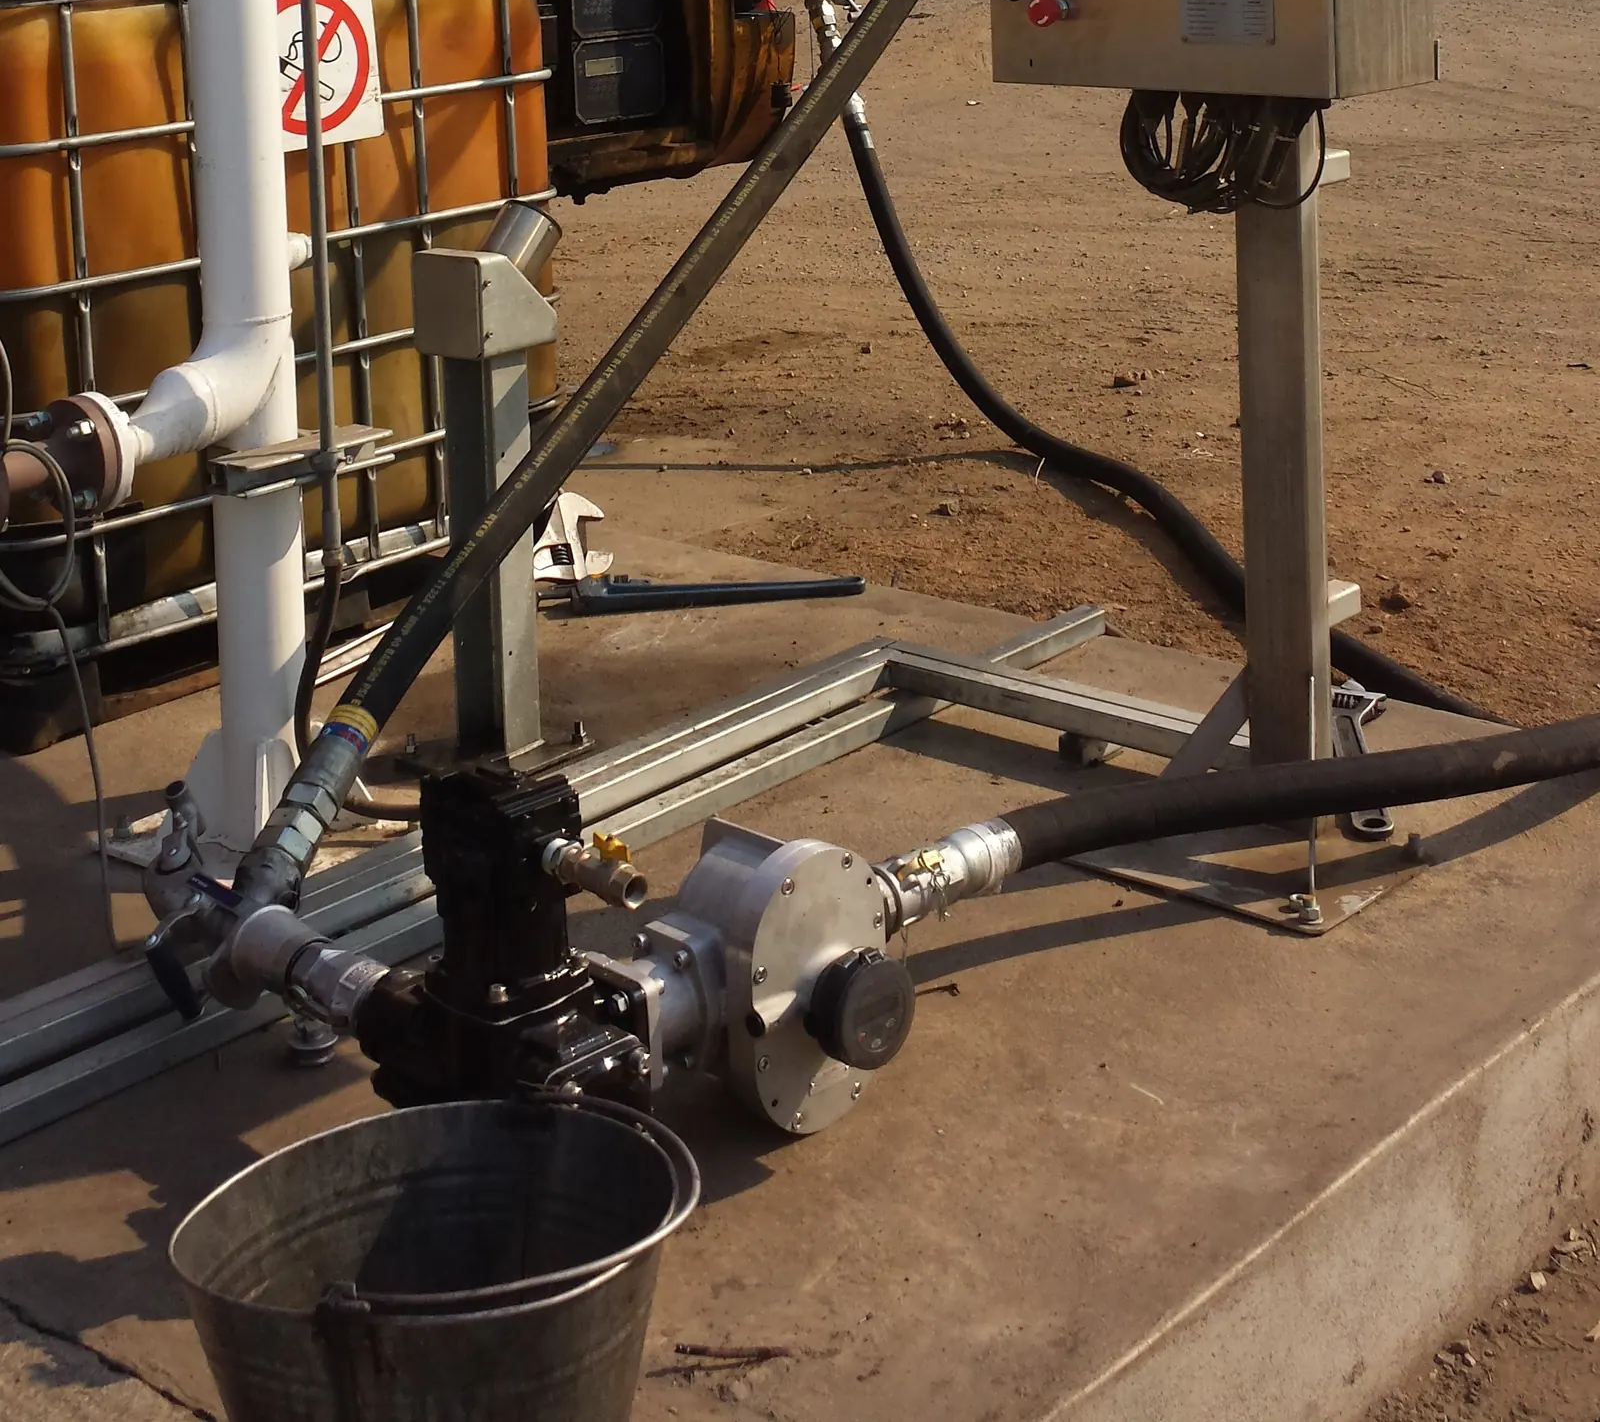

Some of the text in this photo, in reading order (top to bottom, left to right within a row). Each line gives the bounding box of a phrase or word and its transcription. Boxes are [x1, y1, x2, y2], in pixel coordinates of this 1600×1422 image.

[828, 55, 848, 78] FLAME
[801, 76, 832, 115] RESISTANT
[731, 172, 761, 208] AVENGER
[563, 398, 588, 426] FLAME
[530, 423, 569, 468] RESISTANT
[441, 538, 476, 580] AVENGER
[421, 576, 447, 606] T132A
